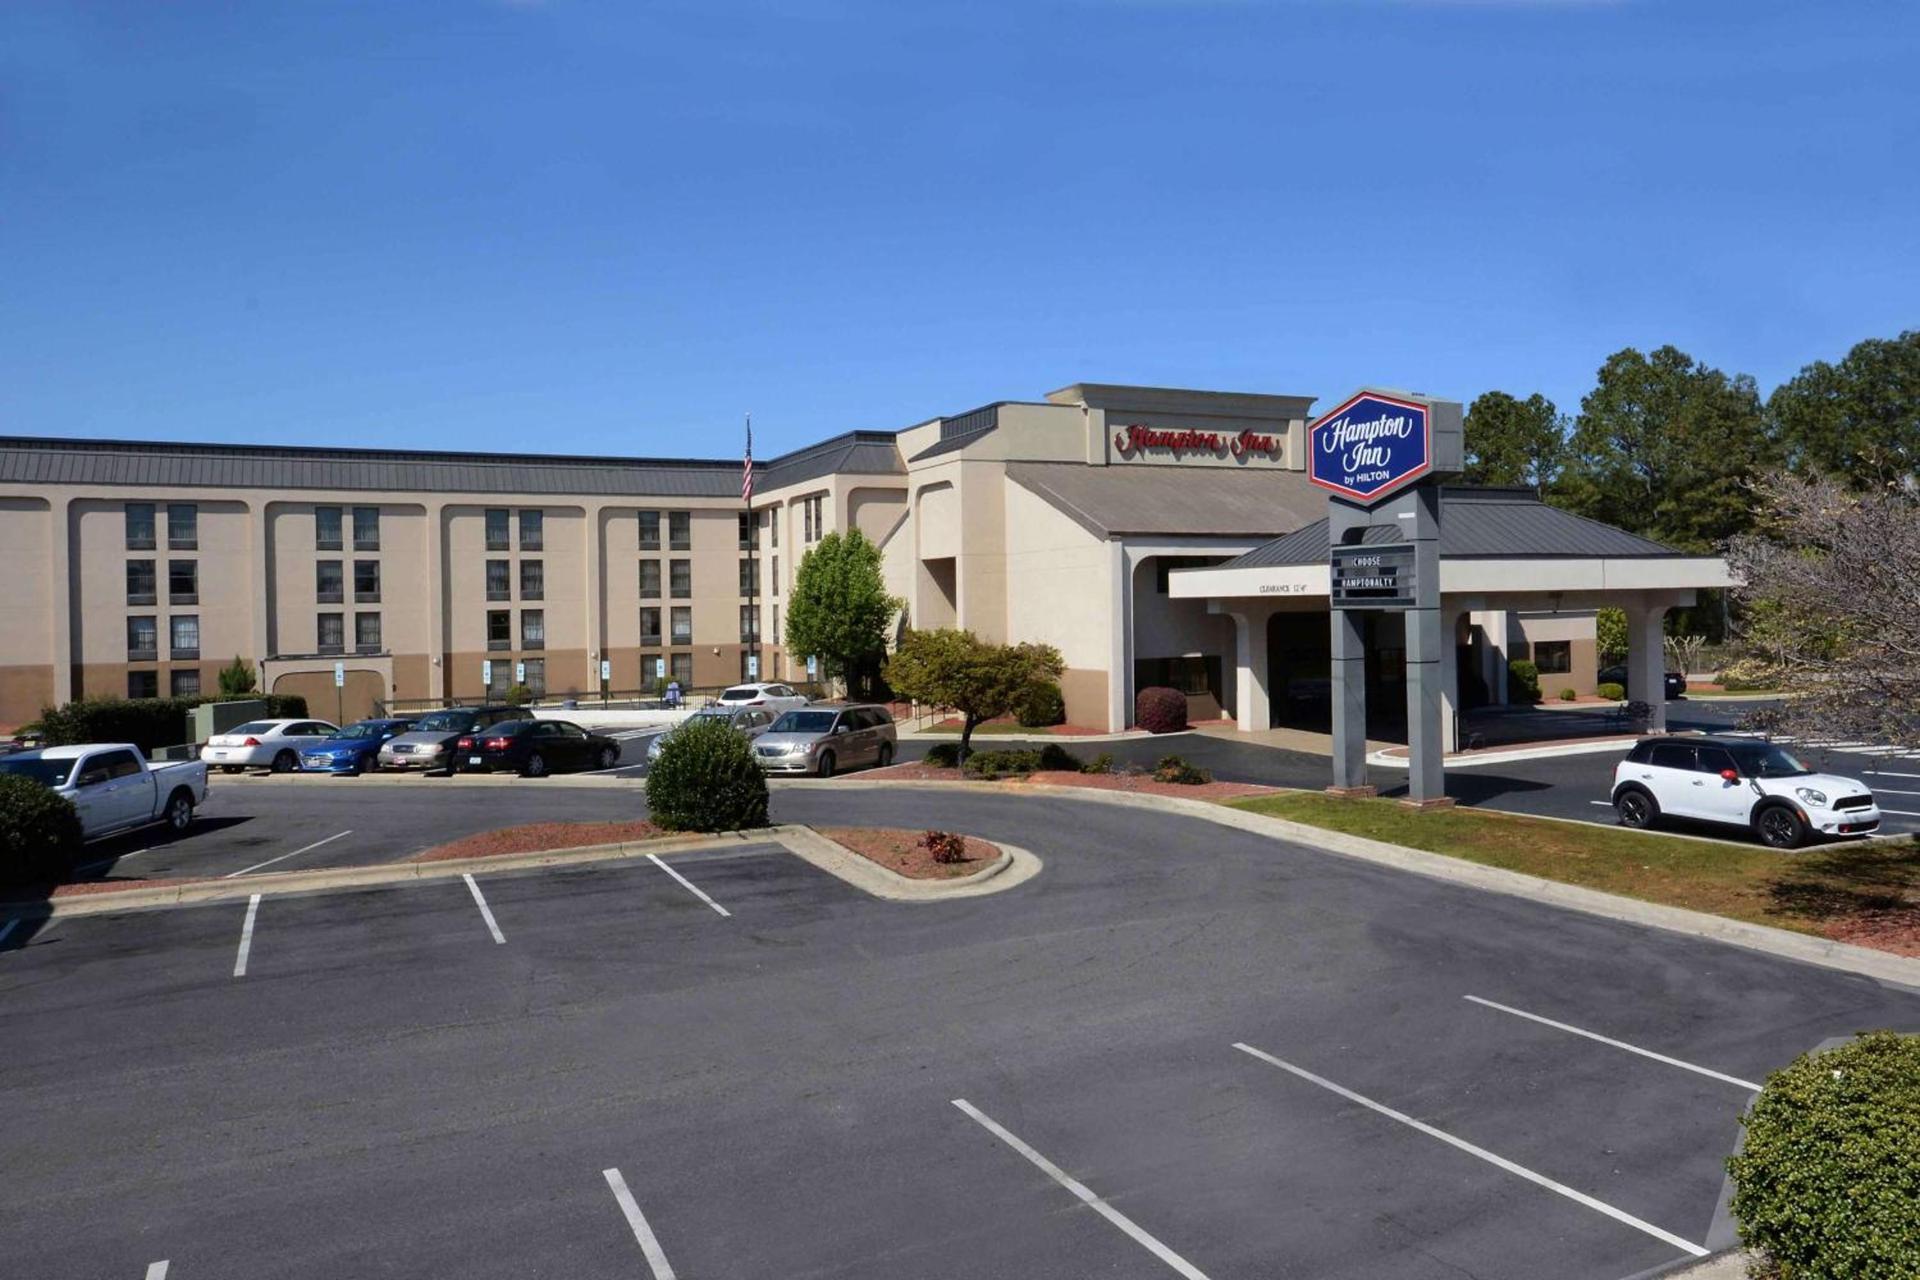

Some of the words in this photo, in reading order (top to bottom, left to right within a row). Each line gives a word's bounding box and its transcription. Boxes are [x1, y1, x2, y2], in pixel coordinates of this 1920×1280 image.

[1114, 424, 1229, 457] Hampton
[1230, 428, 1283, 458] Inn
[1323, 414, 1413, 453] Hampton
[1343, 442, 1391, 473] Inn
[1344, 475, 1355, 486] by
[1356, 470, 1390, 483] HILTON
[1353, 556, 1381, 567] CHOOSE
